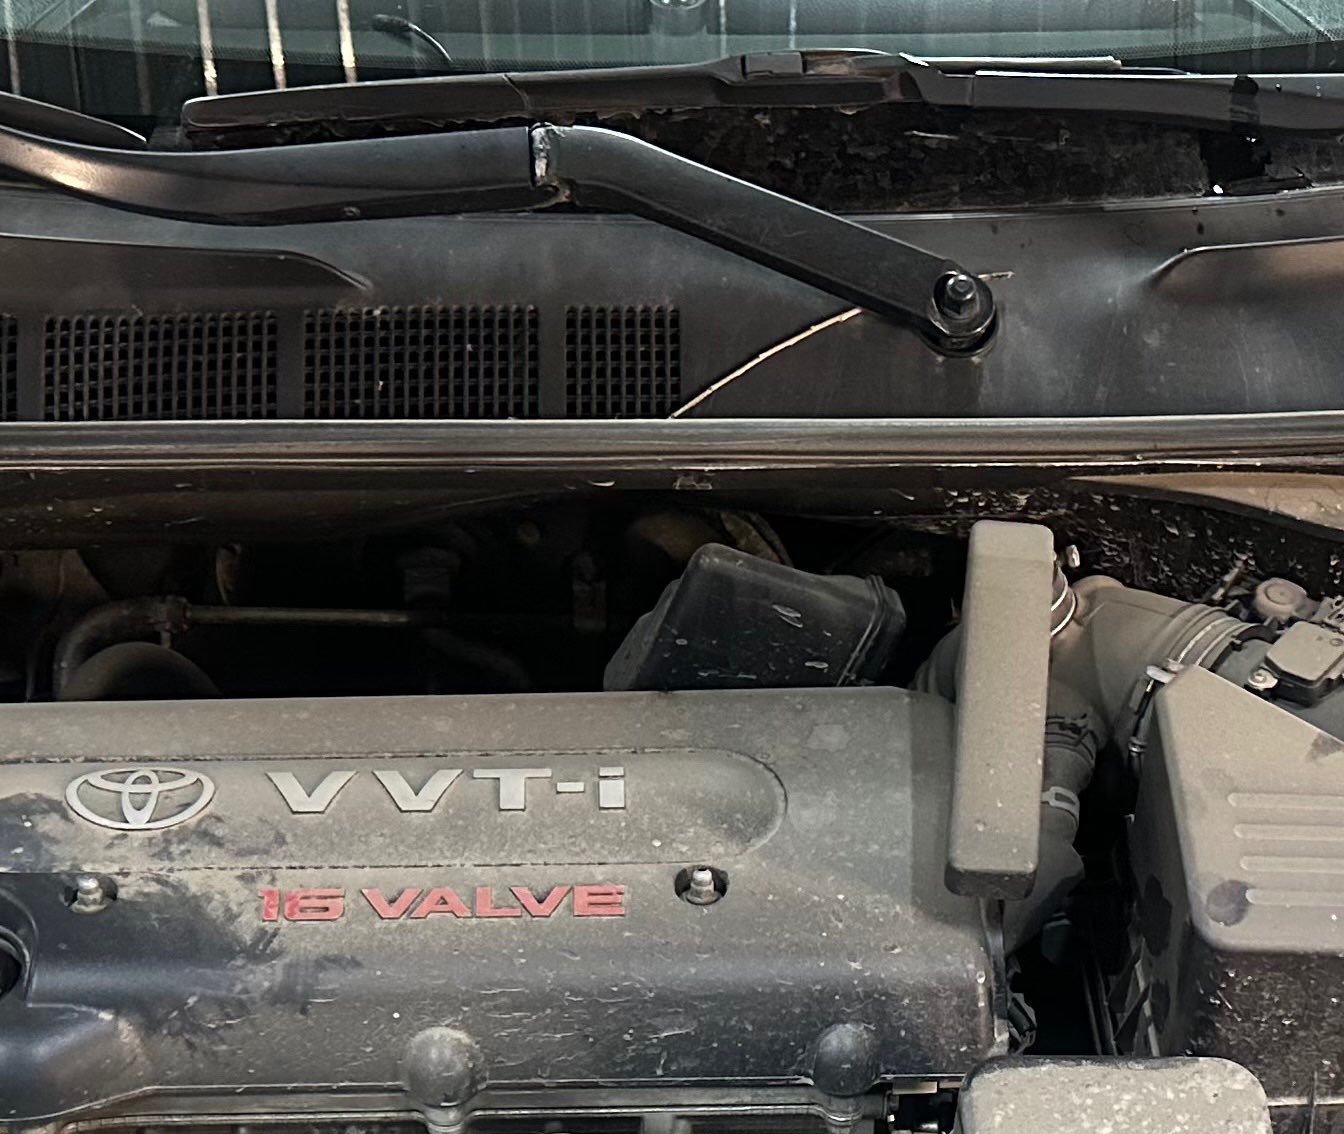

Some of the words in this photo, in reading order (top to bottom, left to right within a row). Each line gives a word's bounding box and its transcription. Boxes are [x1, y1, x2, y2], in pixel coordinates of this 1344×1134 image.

[265, 766, 627, 815] VVT-i
[258, 887, 345, 922] 16
[361, 884, 626, 920] VALVE
